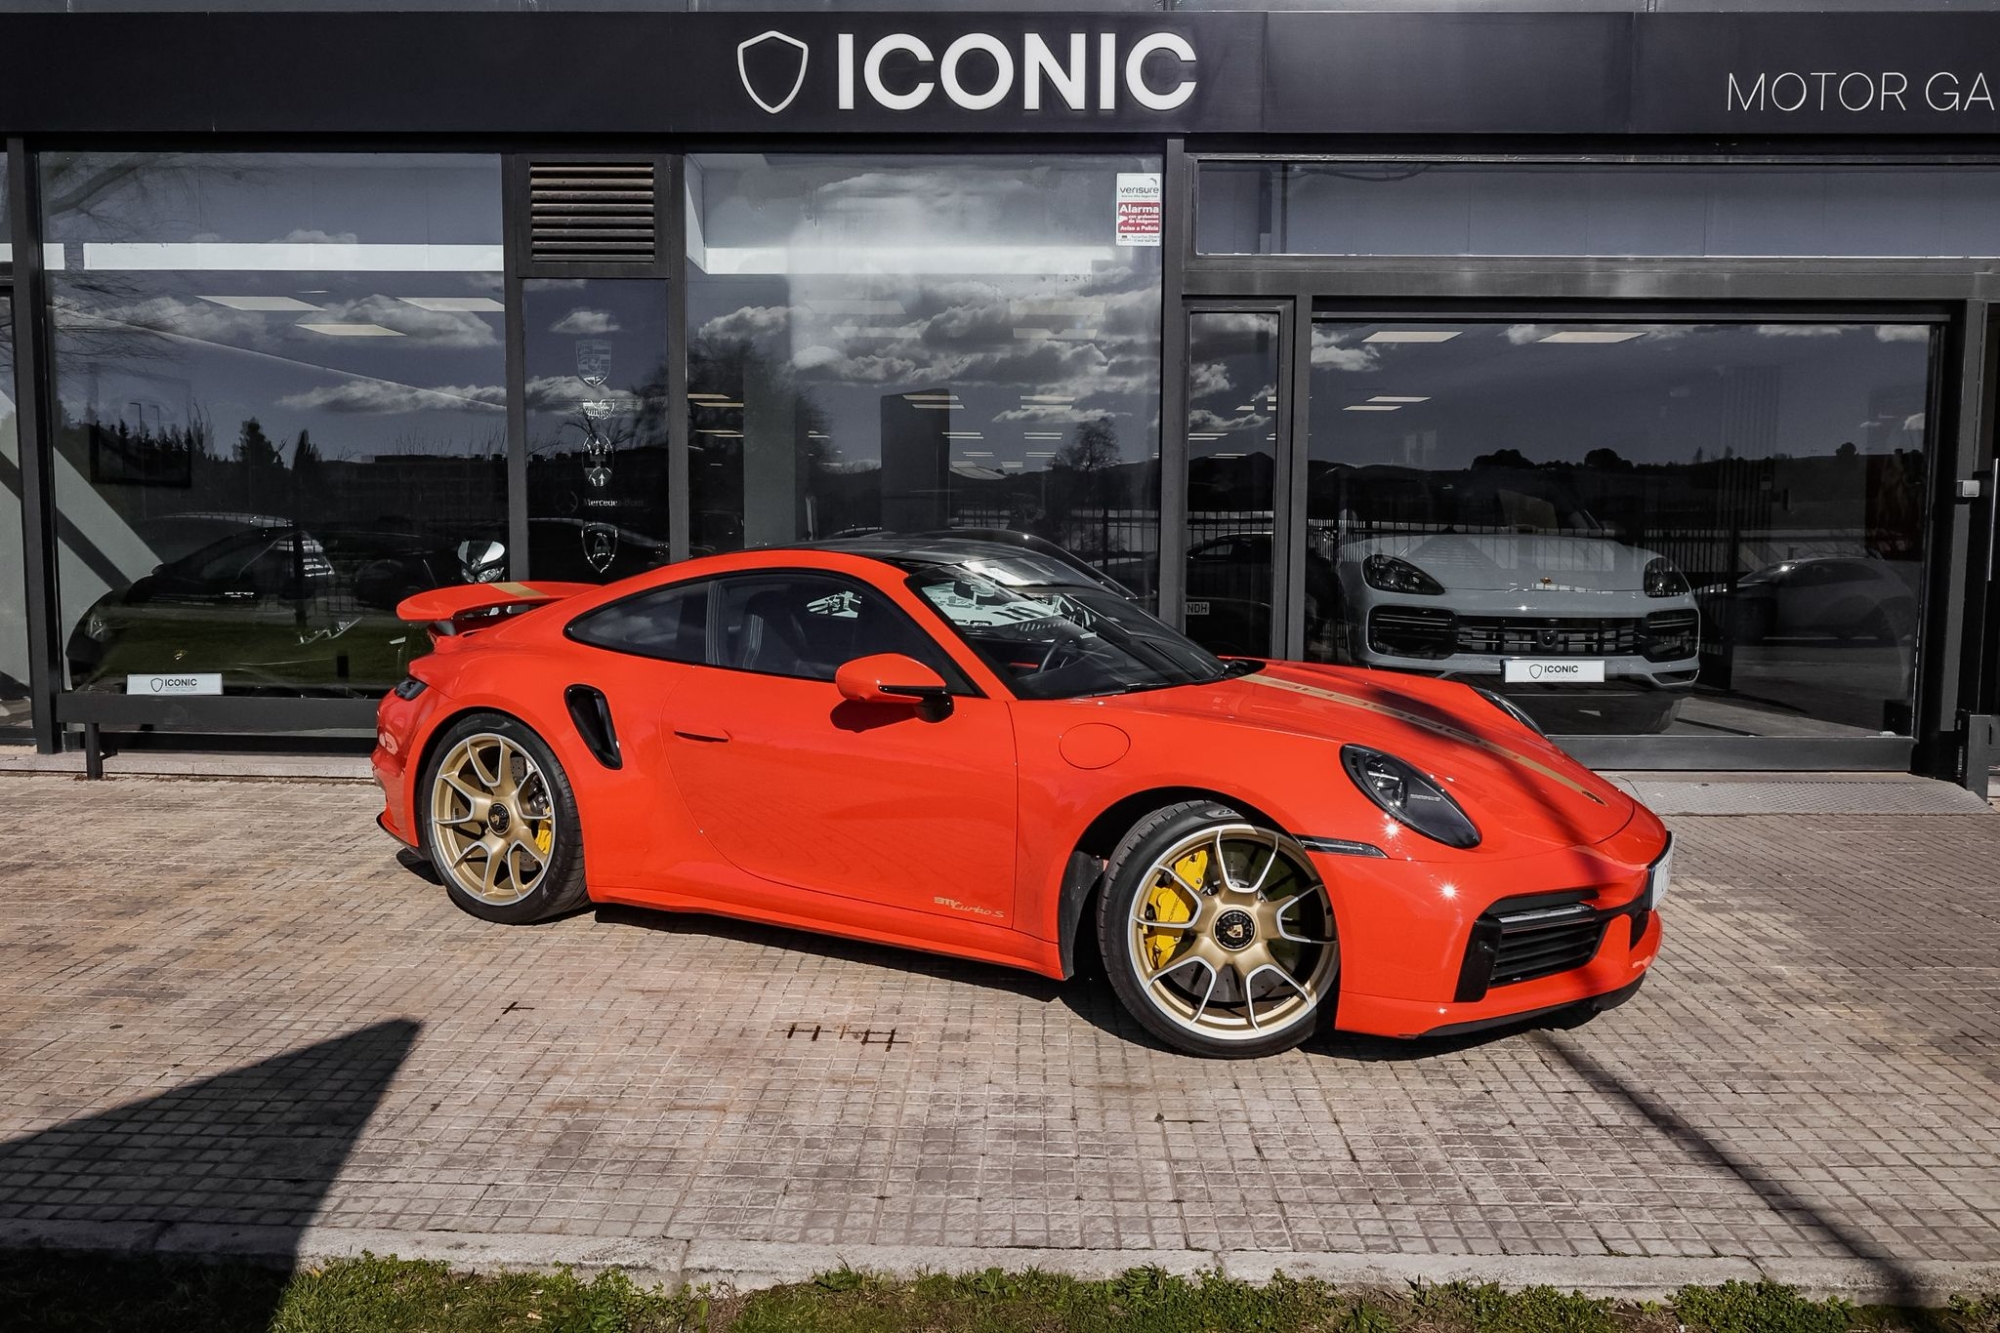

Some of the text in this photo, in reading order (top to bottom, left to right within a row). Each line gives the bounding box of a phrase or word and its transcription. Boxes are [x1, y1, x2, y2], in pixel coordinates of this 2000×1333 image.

[838, 32, 1197, 111] ICONIC
[1727, 72, 1995, 111] MOTOR GA
[1120, 186, 1159, 194] verisure
[1120, 204, 1159, 213] Alarma
[1187, 603, 1207, 613] NDH
[1544, 665, 1579, 673] ICONIC
[164, 678, 197, 687] ICONIC
